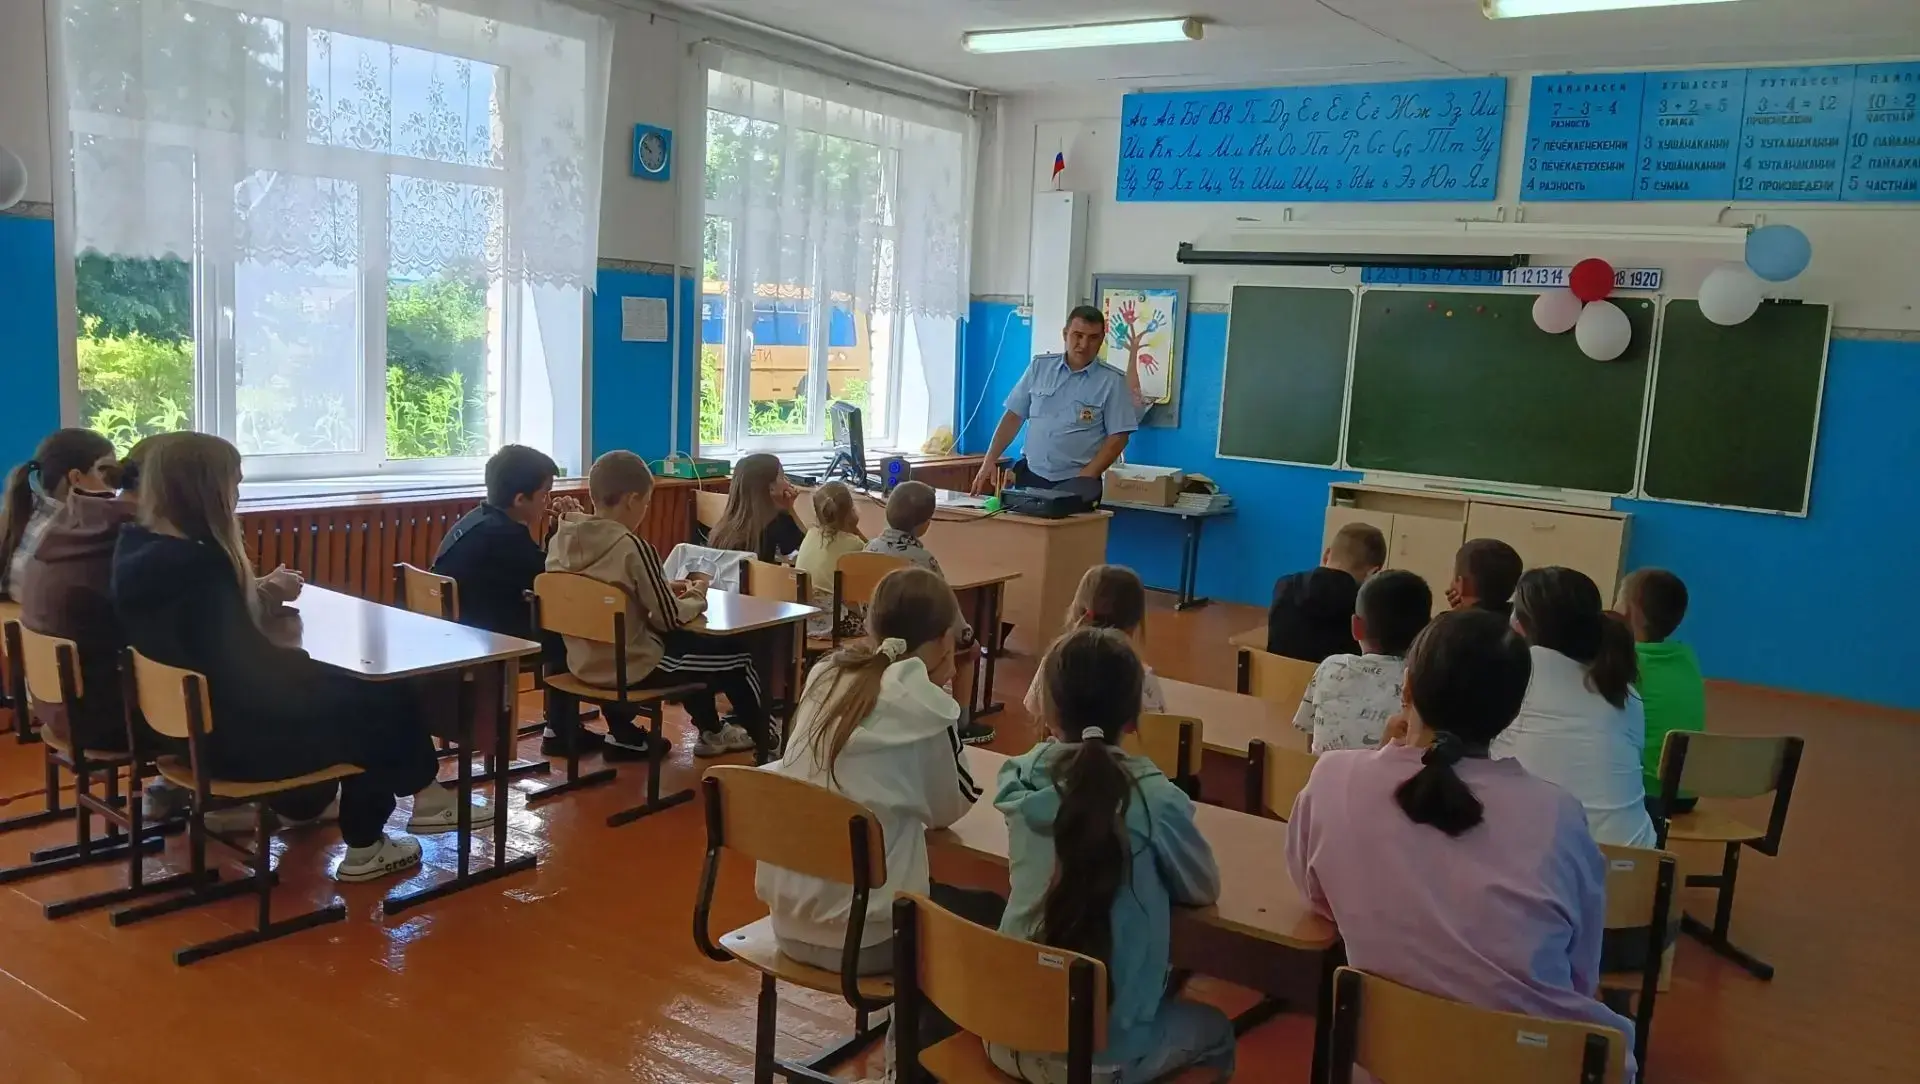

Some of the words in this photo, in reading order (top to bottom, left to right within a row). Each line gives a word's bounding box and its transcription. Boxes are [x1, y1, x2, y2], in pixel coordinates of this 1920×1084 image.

[1658, 98, 1668, 113] 3
[1688, 98, 1698, 113] 2
[1717, 98, 1728, 112] 5
[1758, 96, 1768, 111] 3
[1786, 96, 1796, 110] 4
[1819, 95, 1837, 111] 12
[1905, 92, 1916, 107] 2
[1180, 100, 1209, 126] Бб
[1209, 100, 1233, 126] Вв
[1261, 98, 1290, 131] Дд
[1297, 96, 1320, 122] Ее
[1385, 92, 1432, 120] Жж
[1438, 91, 1462, 126] Зз
[1470, 88, 1499, 117] Ии
[1553, 102, 1562, 116] 7
[1580, 101, 1590, 115] 3
[1608, 100, 1618, 114] 4
[1551, 119, 1590, 128] РАЗНОСТЬ
[1658, 118, 1695, 127] СУММА
[1149, 134, 1175, 158] Кк
[1176, 132, 1202, 158] Лл
[1207, 132, 1244, 158] Мм
[1248, 132, 1272, 156] Нн
[1278, 132, 1296, 156] Оо
[1300, 131, 1332, 156] Пп
[1337, 129, 1360, 164] Рр
[1367, 130, 1386, 154] Сс
[1418, 127, 1465, 153] Тт
[1472, 125, 1496, 162] Уу
[1531, 138, 1540, 151] 7
[1644, 135, 1652, 149] 3
[1744, 135, 1754, 149] 3
[1851, 132, 1868, 148] 10
[1529, 157, 1538, 171] 3
[1641, 157, 1651, 170] 2
[1743, 156, 1752, 170] 4
[1850, 154, 1862, 169] 2
[1143, 167, 1164, 200] Фф
[1168, 167, 1194, 190] Хх
[1198, 167, 1222, 194] Цц
[1228, 166, 1246, 190] Чч
[1251, 166, 1285, 190] Шш
[1291, 165, 1329, 192] Щщ
[1349, 165, 1374, 189] Ыы
[1395, 164, 1416, 189] Ээ
[1420, 163, 1456, 189] Юю
[1462, 163, 1489, 189] Яя
[1526, 177, 1535, 190] 4
[1539, 180, 1585, 191] РАЗНОСТЬ
[1640, 176, 1649, 190] 5
[1653, 180, 1690, 190] СУММА
[1738, 176, 1754, 191] 12
[1848, 175, 1858, 191] 5
[1507, 270, 1517, 284] 11
[1522, 269, 1533, 284] 12
[1536, 270, 1548, 284] 13
[1551, 270, 1563, 285] 14
[1615, 271, 1626, 285] 18
[385, 853, 419, 871] crocs
